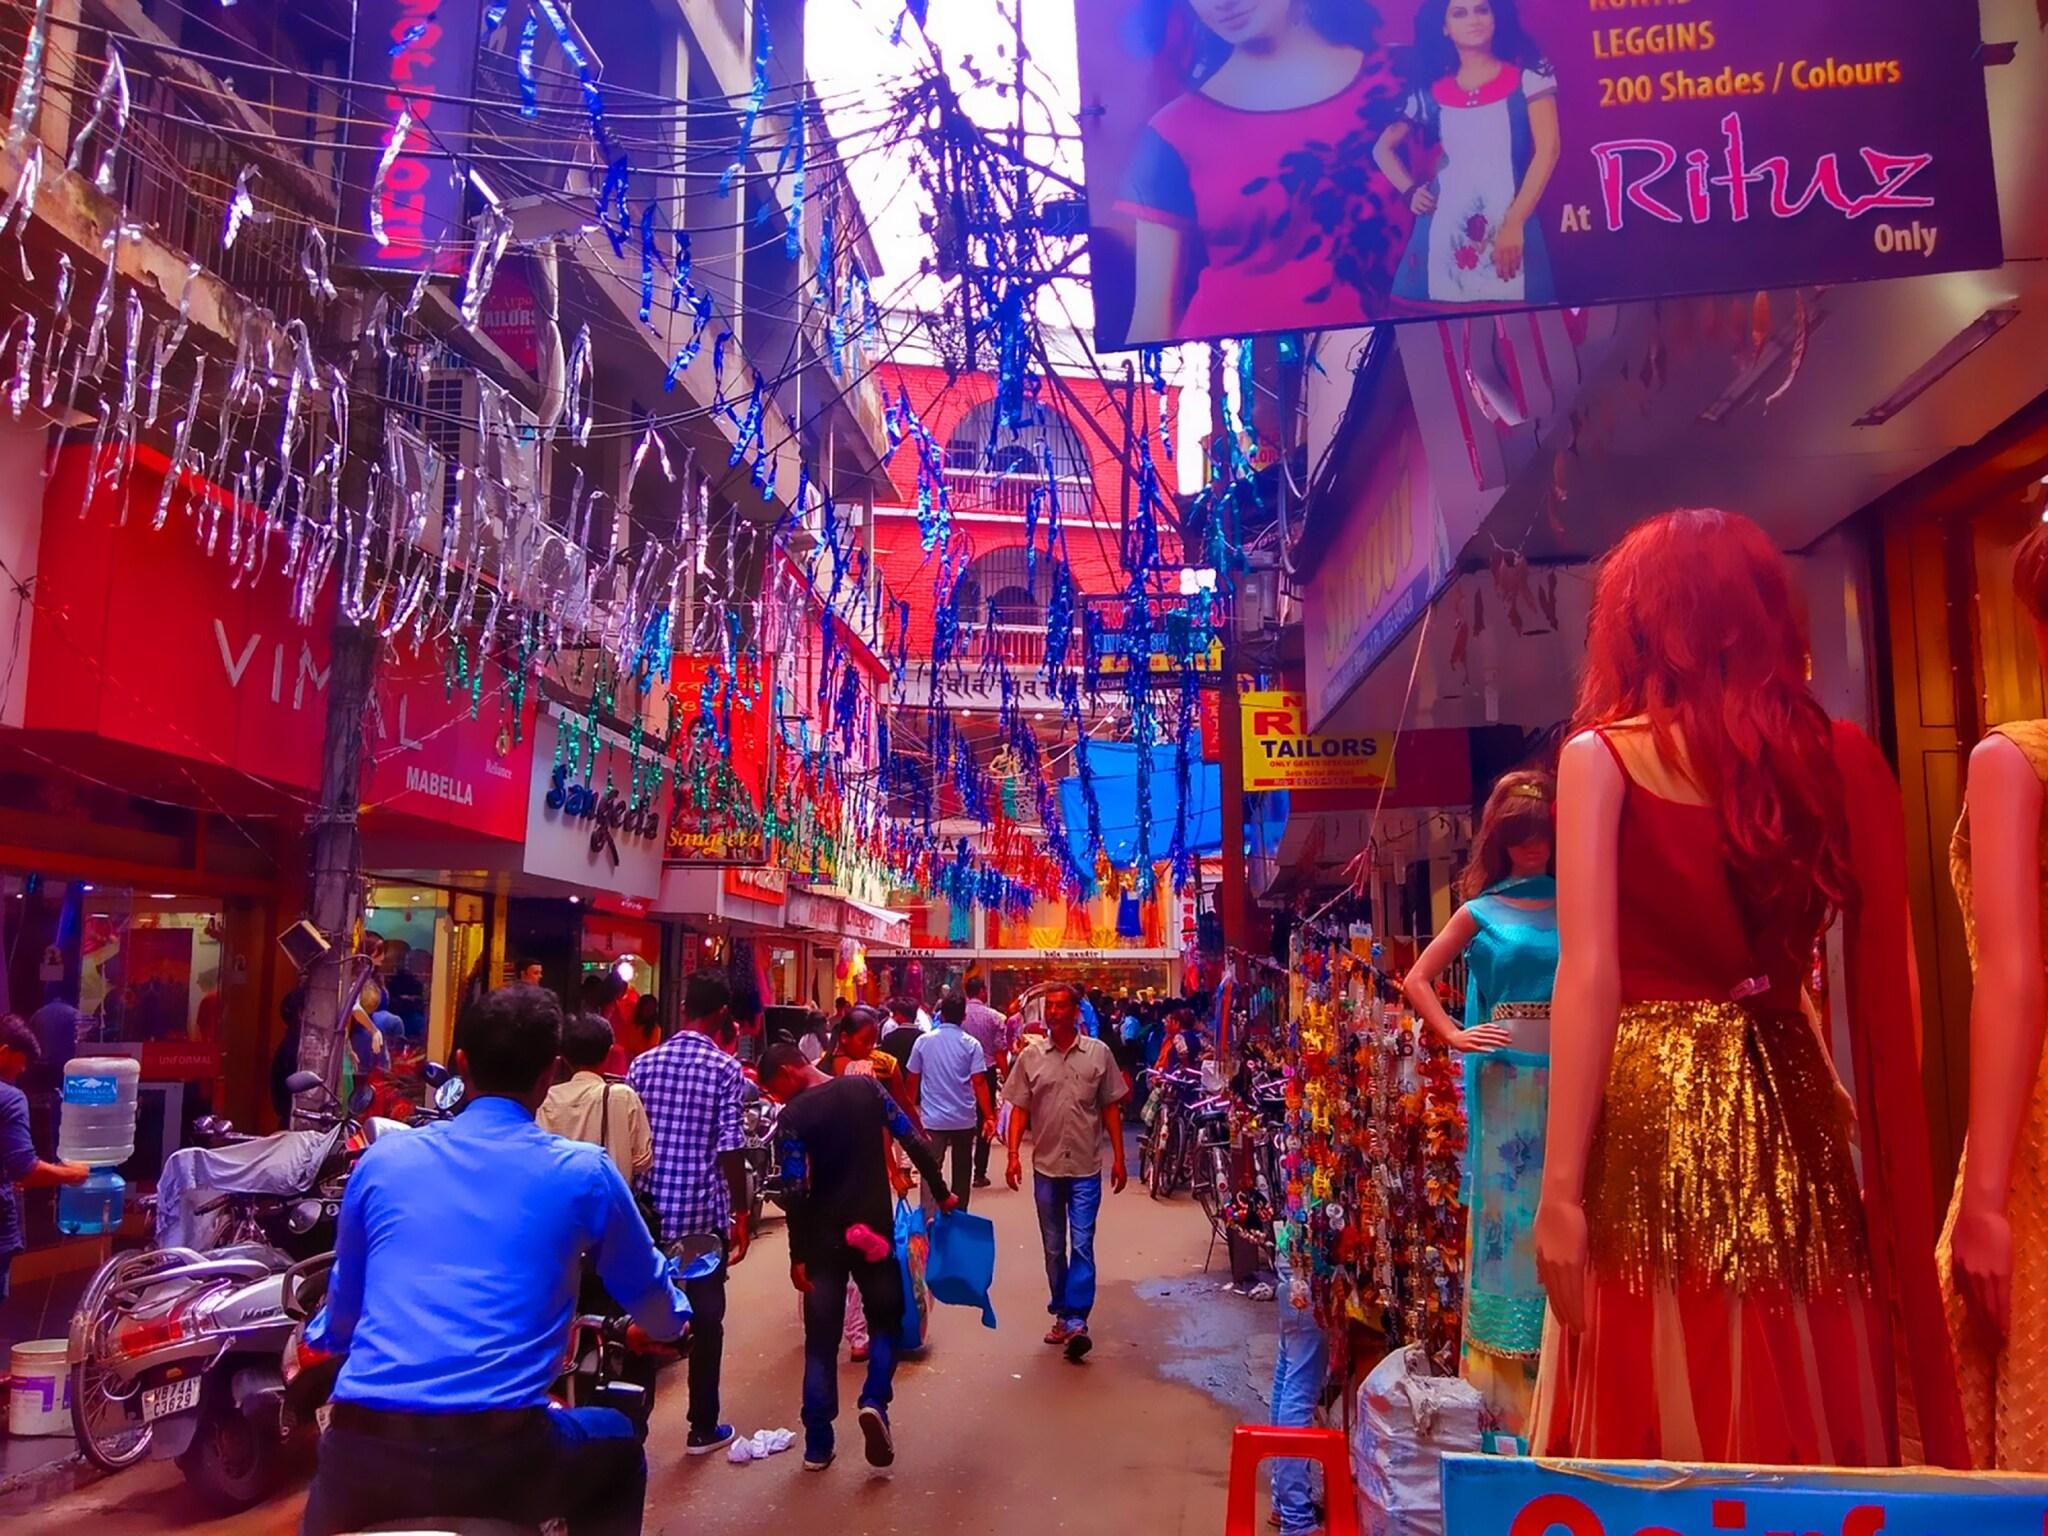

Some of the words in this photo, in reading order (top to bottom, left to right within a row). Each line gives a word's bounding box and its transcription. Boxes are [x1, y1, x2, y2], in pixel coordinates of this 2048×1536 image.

[1592, 20, 1716, 59] LEGGINS
[1599, 76, 1653, 107] 200
[1660, 66, 1765, 102] Shades
[1791, 57, 1900, 90] Colours
[1560, 204, 1592, 232] At
[1591, 111, 1935, 231] Rituz
[1874, 221, 1937, 257] Only
[1260, 738, 1377, 758] TAILORS
[405, 765, 474, 807] MABELLA
